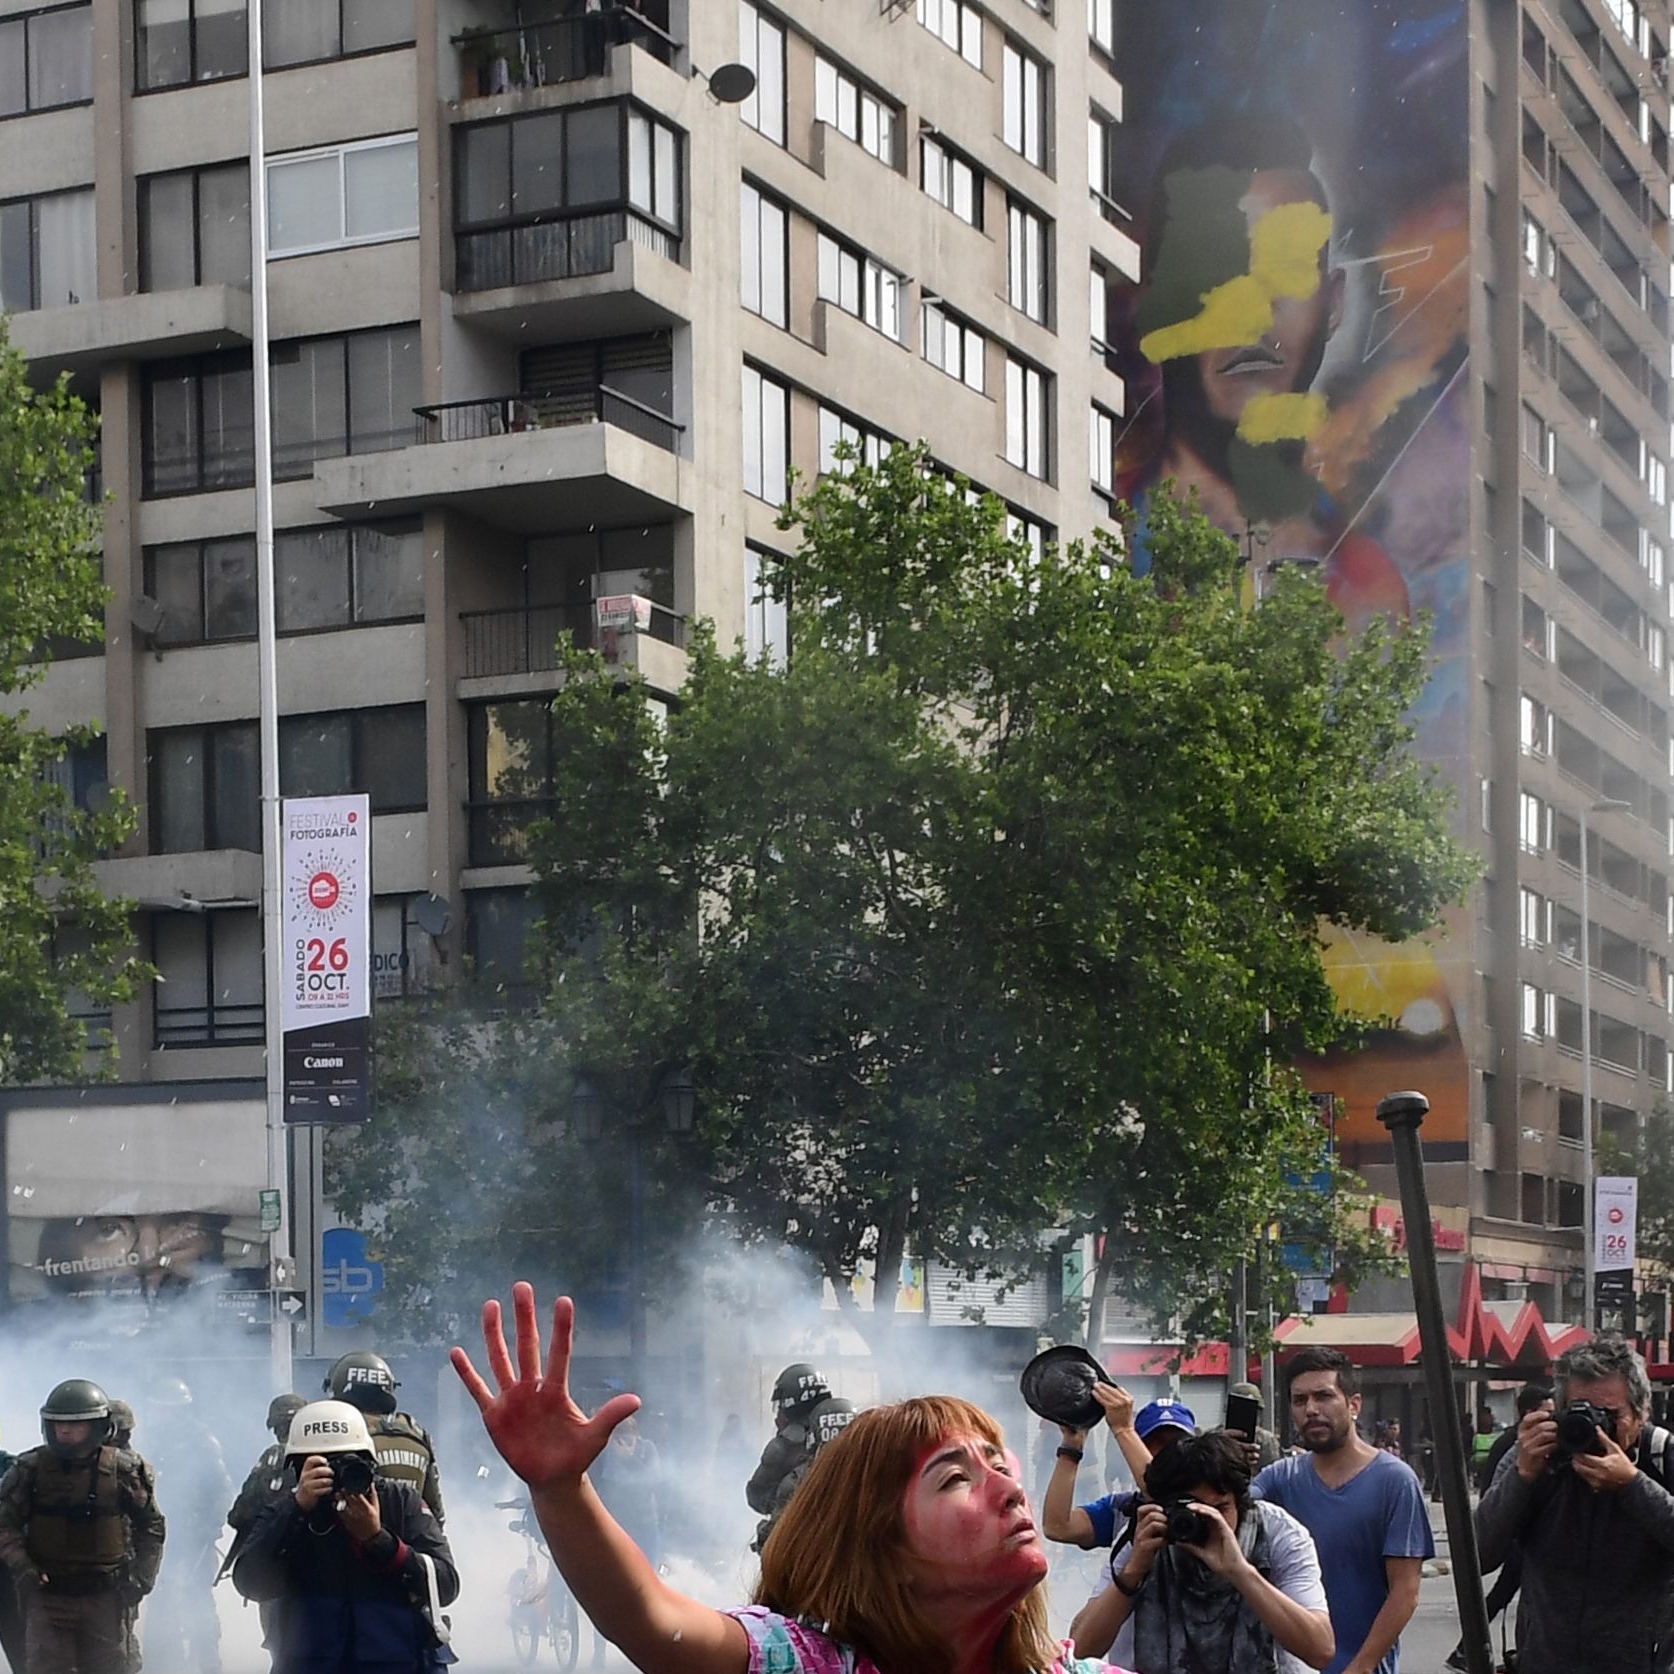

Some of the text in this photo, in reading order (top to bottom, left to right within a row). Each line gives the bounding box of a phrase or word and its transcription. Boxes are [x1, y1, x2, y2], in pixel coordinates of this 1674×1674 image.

[290, 825, 357, 840] FOTOGRAFÍA
[307, 937, 349, 971] 26
[308, 973, 350, 991] OCT.
[303, 1056, 344, 1069] Canon
[1607, 1235, 1627, 1249] 26
[304, 1421, 349, 1437] PRESS
